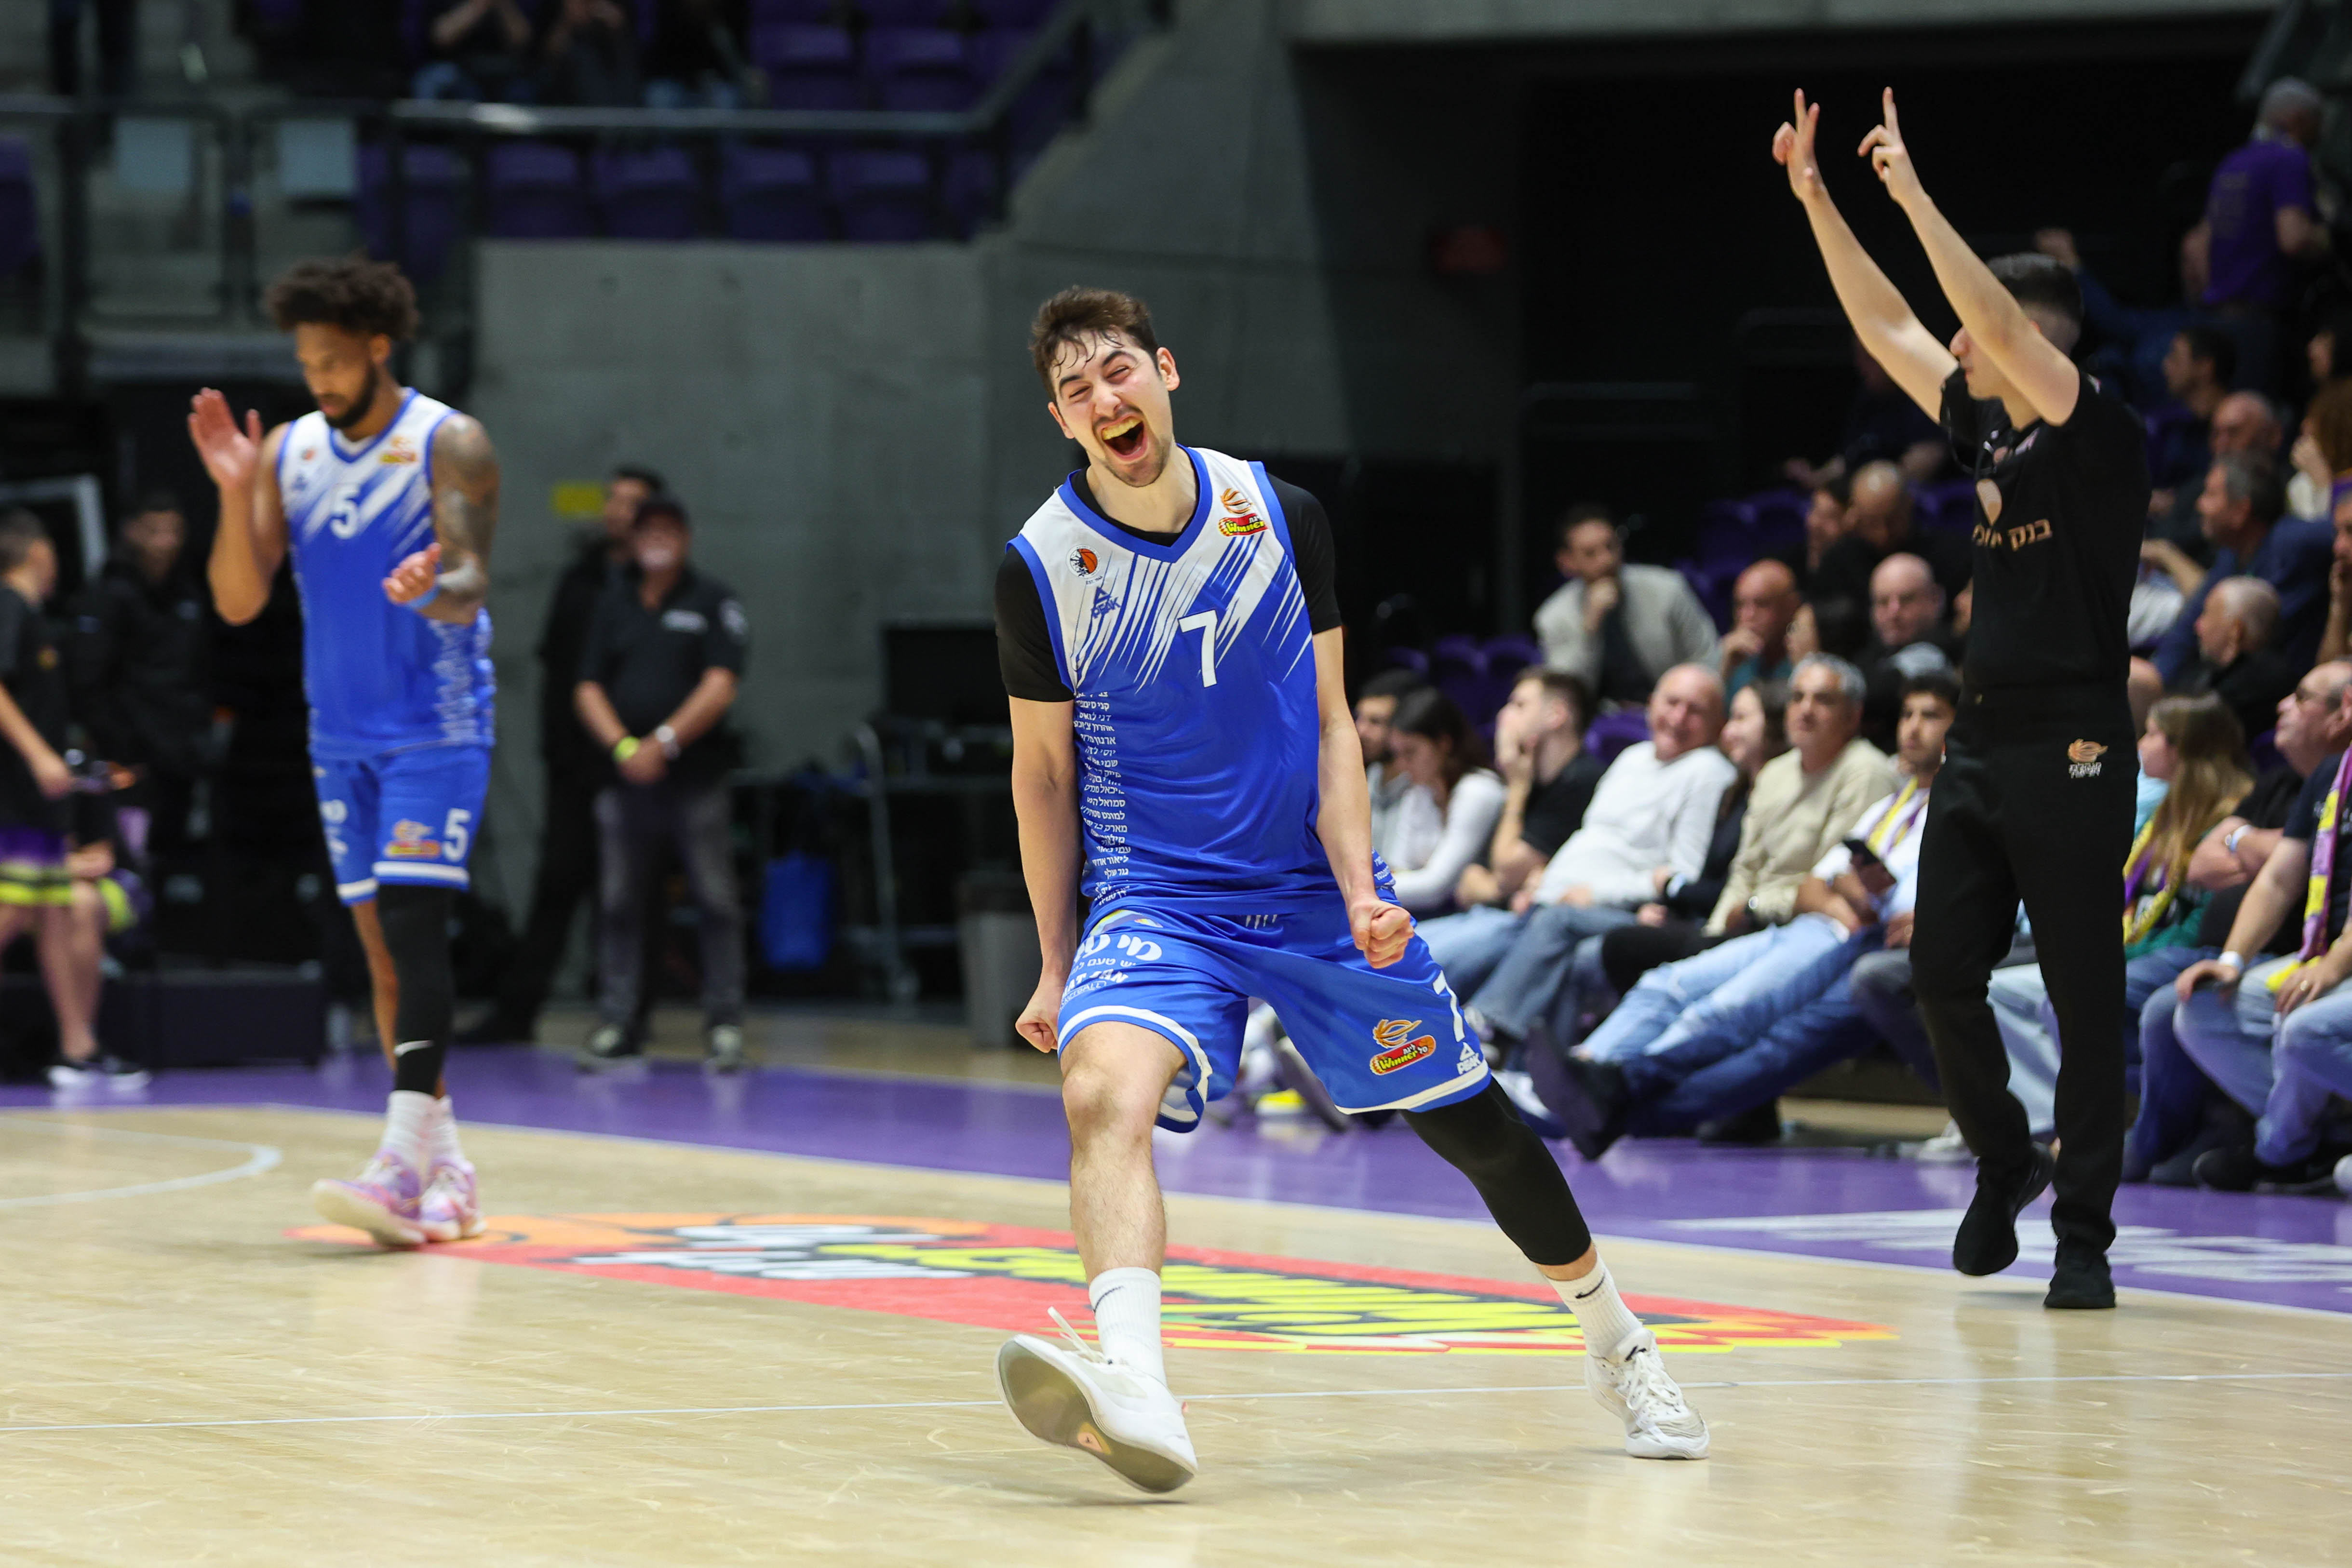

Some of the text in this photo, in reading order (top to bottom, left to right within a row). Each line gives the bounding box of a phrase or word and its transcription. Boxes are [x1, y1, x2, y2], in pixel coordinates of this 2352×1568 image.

[330, 487, 361, 539] 5
[2008, 519, 2052, 551] בנק
[1090, 596, 1121, 619] PEAK
[1179, 610, 1217, 687] 7
[1098, 796, 1126, 807] סמואל
[442, 808, 471, 861] 5
[1103, 825, 1128, 833] מארק
[1106, 855, 1129, 864] ליאור
[1432, 970, 1465, 1043] 7
[1378, 1050, 1418, 1070] Winner
[1456, 1052, 1481, 1075] PEAK
